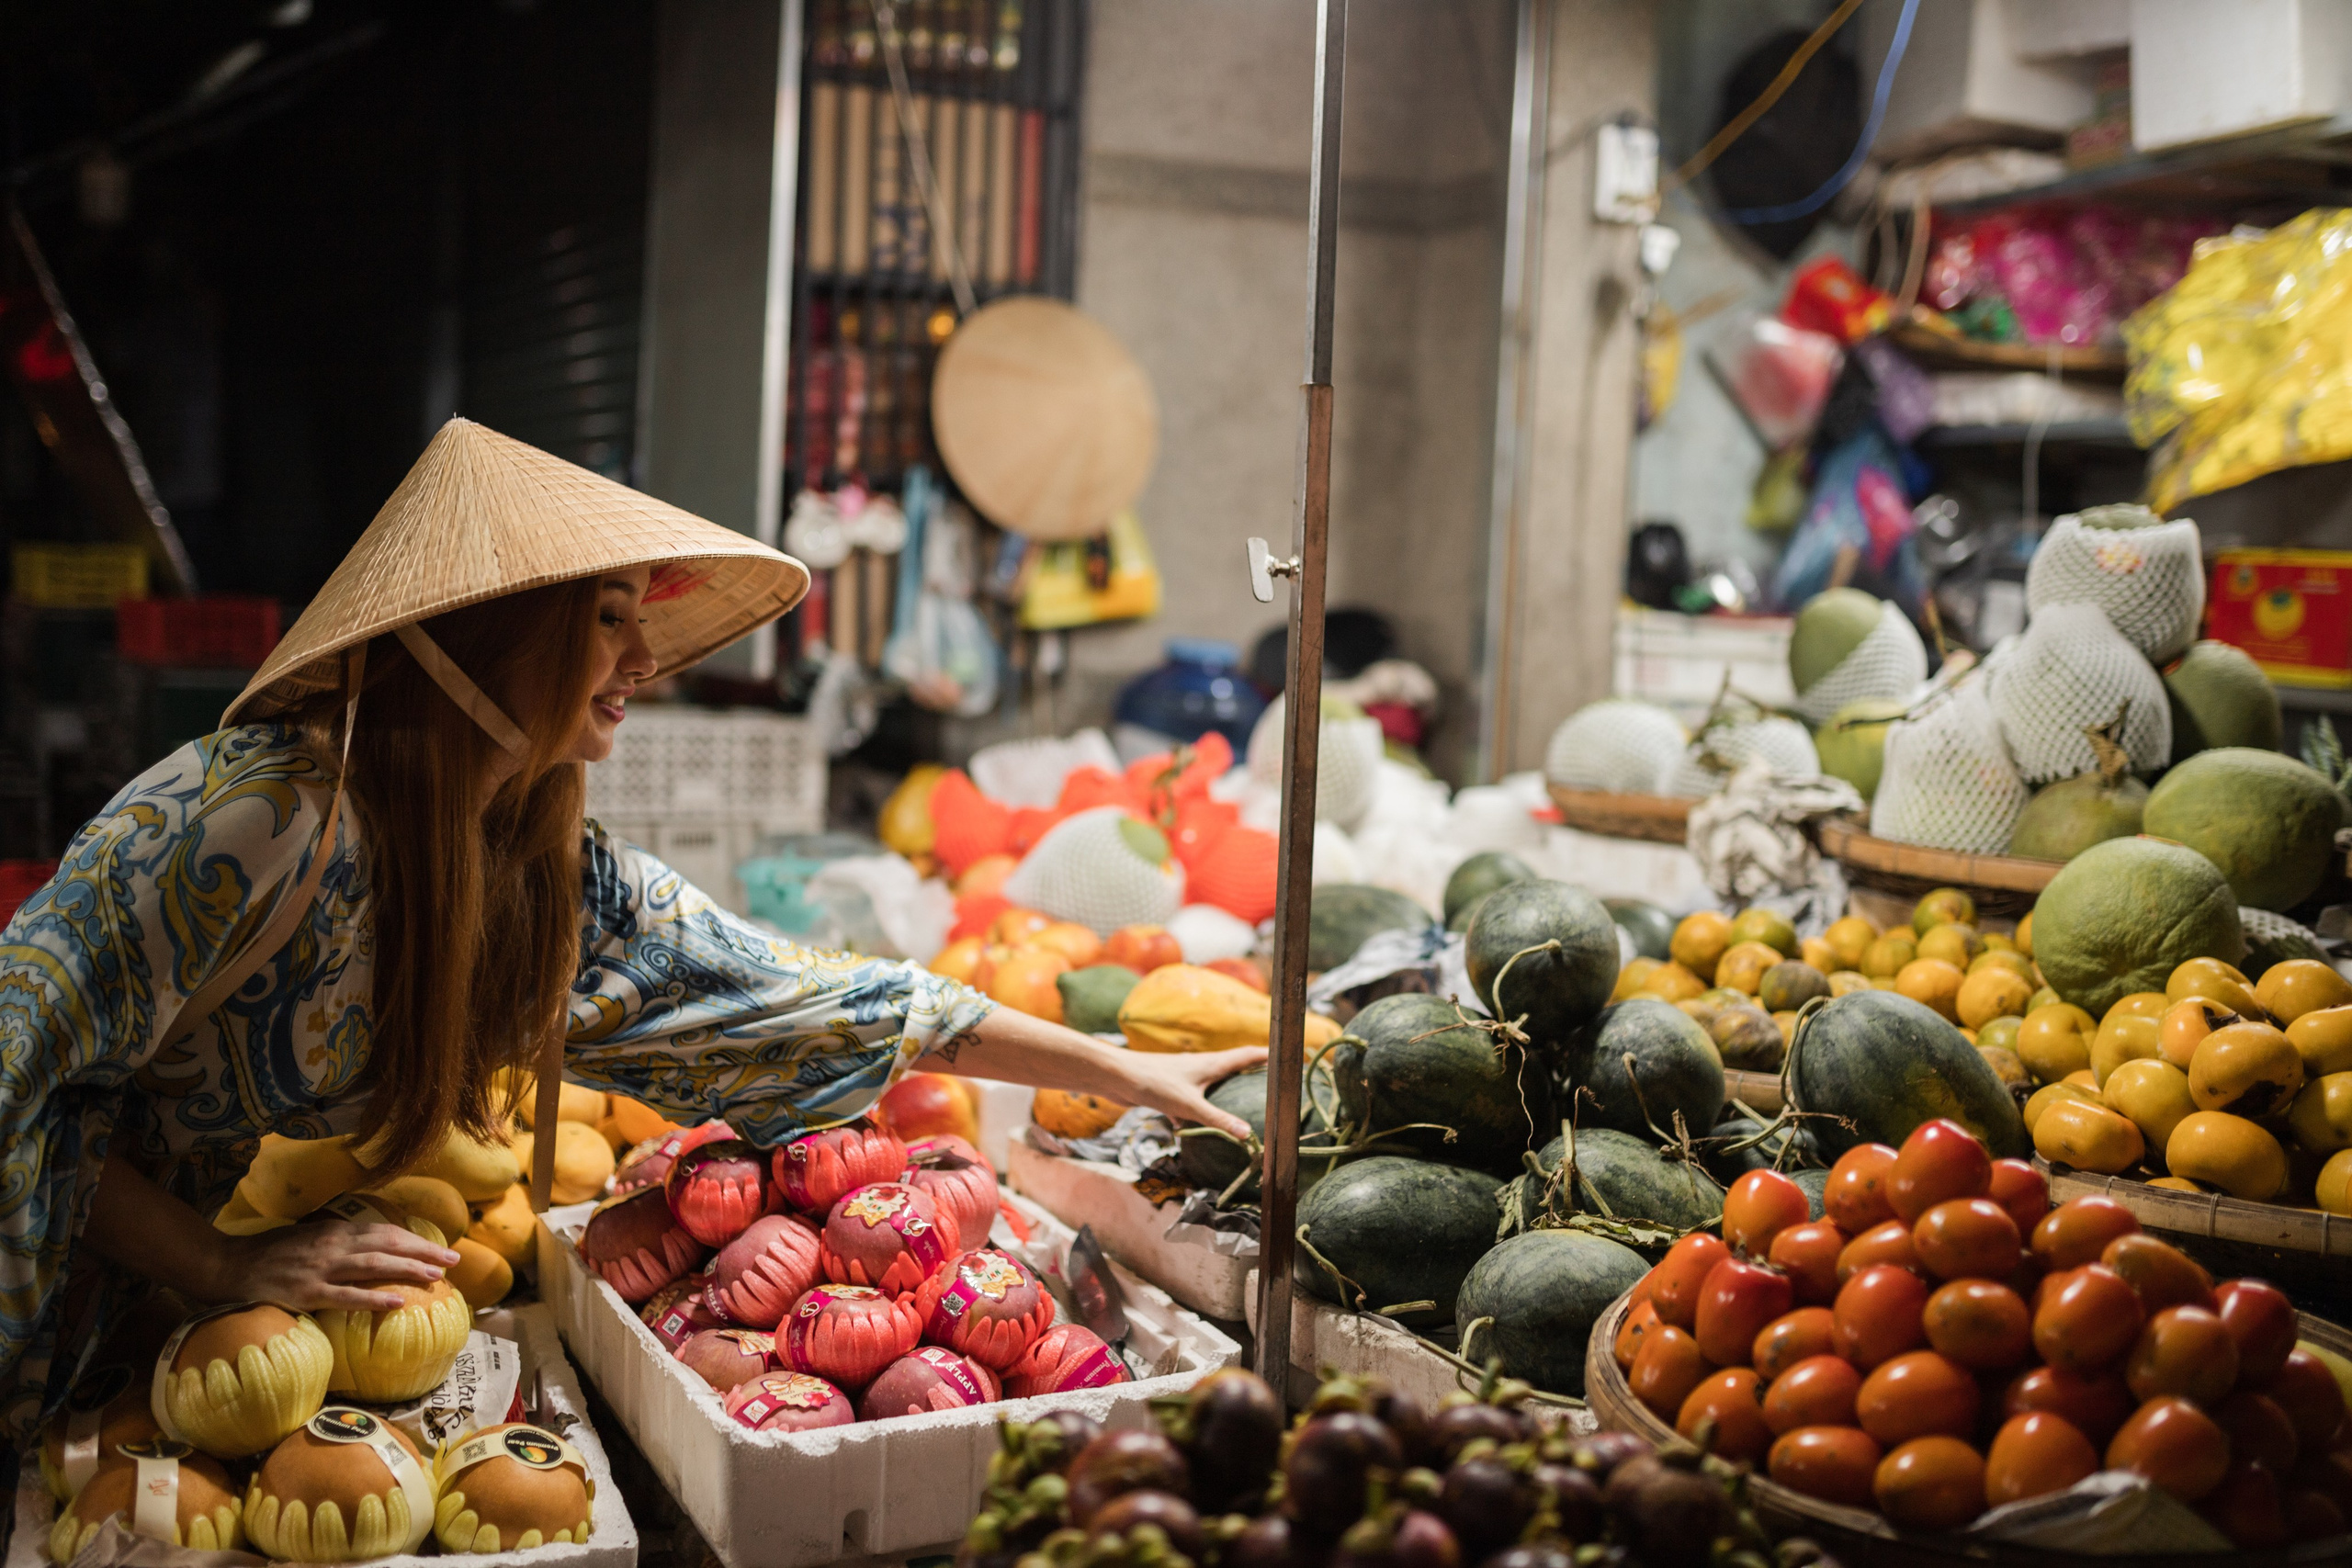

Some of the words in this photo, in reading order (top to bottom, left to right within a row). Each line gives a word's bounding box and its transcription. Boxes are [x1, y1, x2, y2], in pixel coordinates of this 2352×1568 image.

[707, 1283, 729, 1320] HELLO
[945, 1361, 978, 1395] APPLE
[1084, 1359, 1111, 1382] Premium
[318, 1415, 351, 1429] Premium
[351, 1425, 369, 1436] Pear
[526, 1441, 560, 1451] Premium
